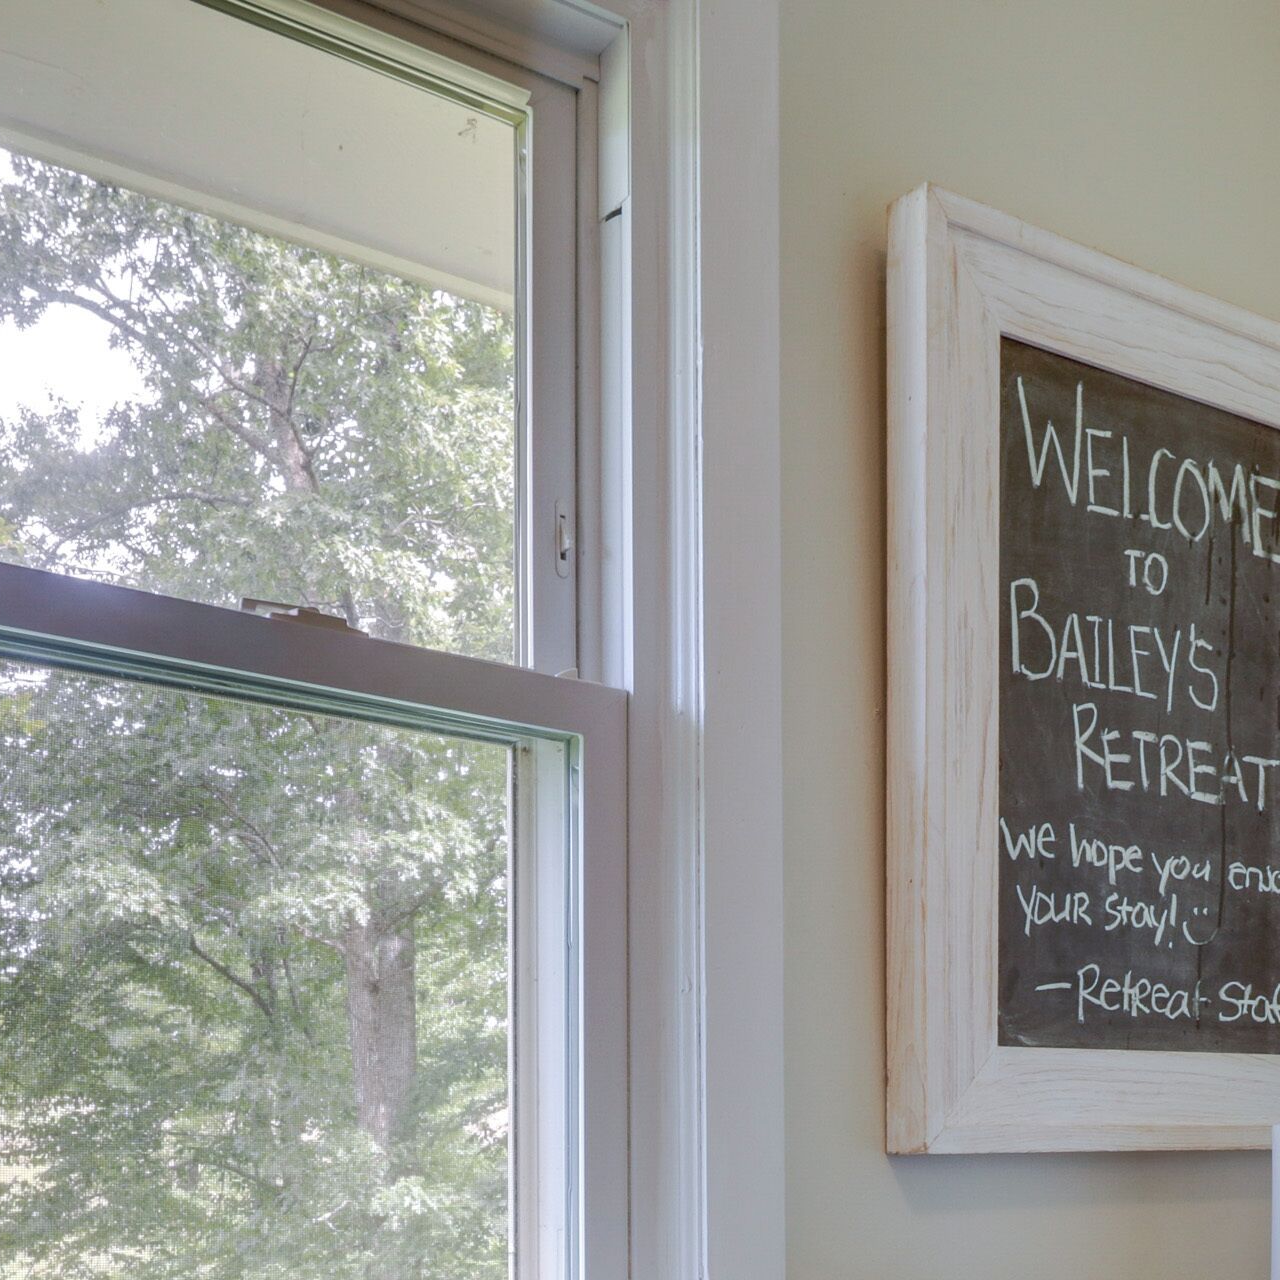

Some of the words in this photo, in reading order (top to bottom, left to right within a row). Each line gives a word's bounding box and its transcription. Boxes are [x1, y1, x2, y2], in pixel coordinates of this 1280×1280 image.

[1124, 549, 1169, 596] TO
[1010, 578, 1218, 714] BAILEY'S
[1069, 822, 1143, 886] hope
[1151, 852, 1211, 897] you
